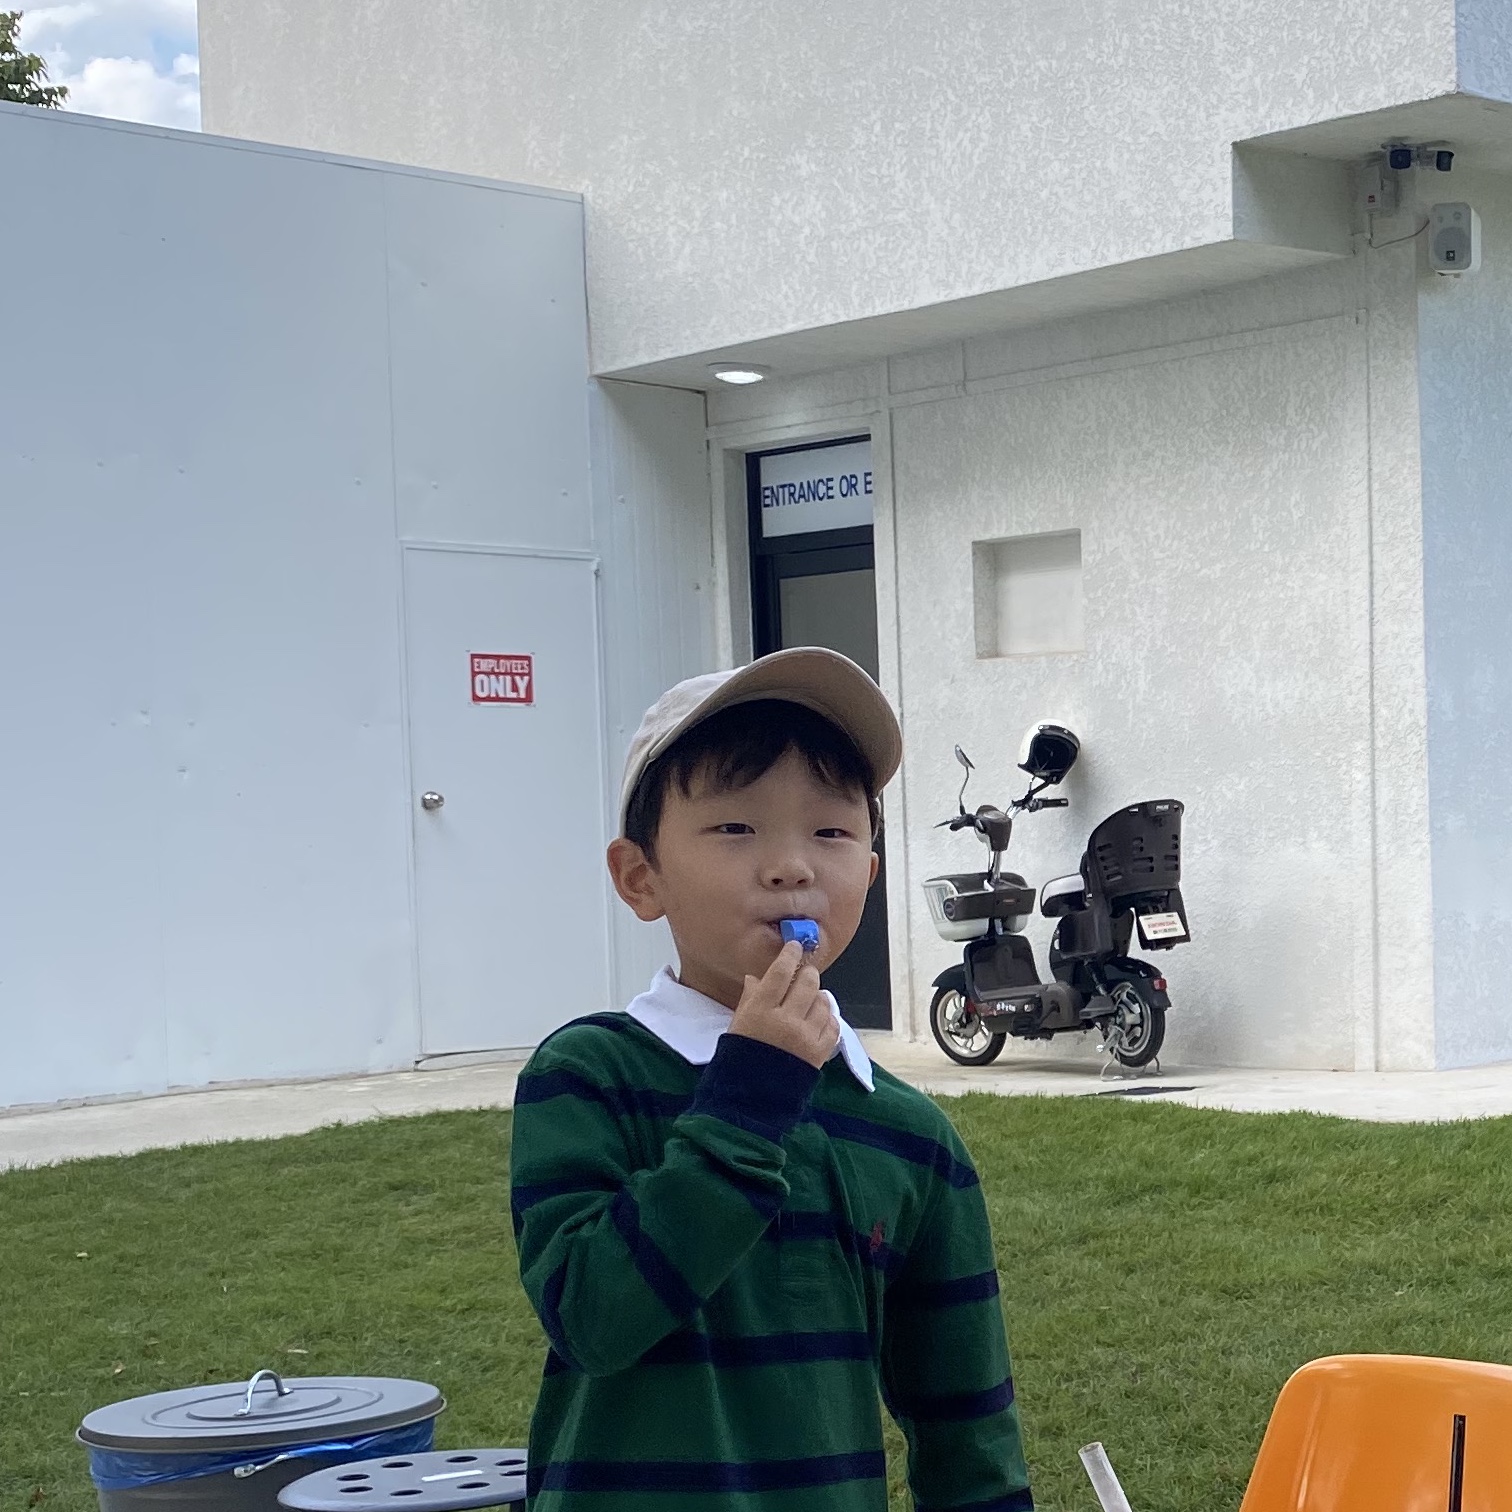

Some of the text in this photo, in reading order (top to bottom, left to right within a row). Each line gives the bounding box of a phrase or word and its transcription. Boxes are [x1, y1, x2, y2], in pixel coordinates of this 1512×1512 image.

[762, 477, 834, 508] ENTRANCE
[839, 473, 859, 498] OR
[473, 658, 529, 673] EMPLOYEES
[474, 673, 530, 699] ONLY
